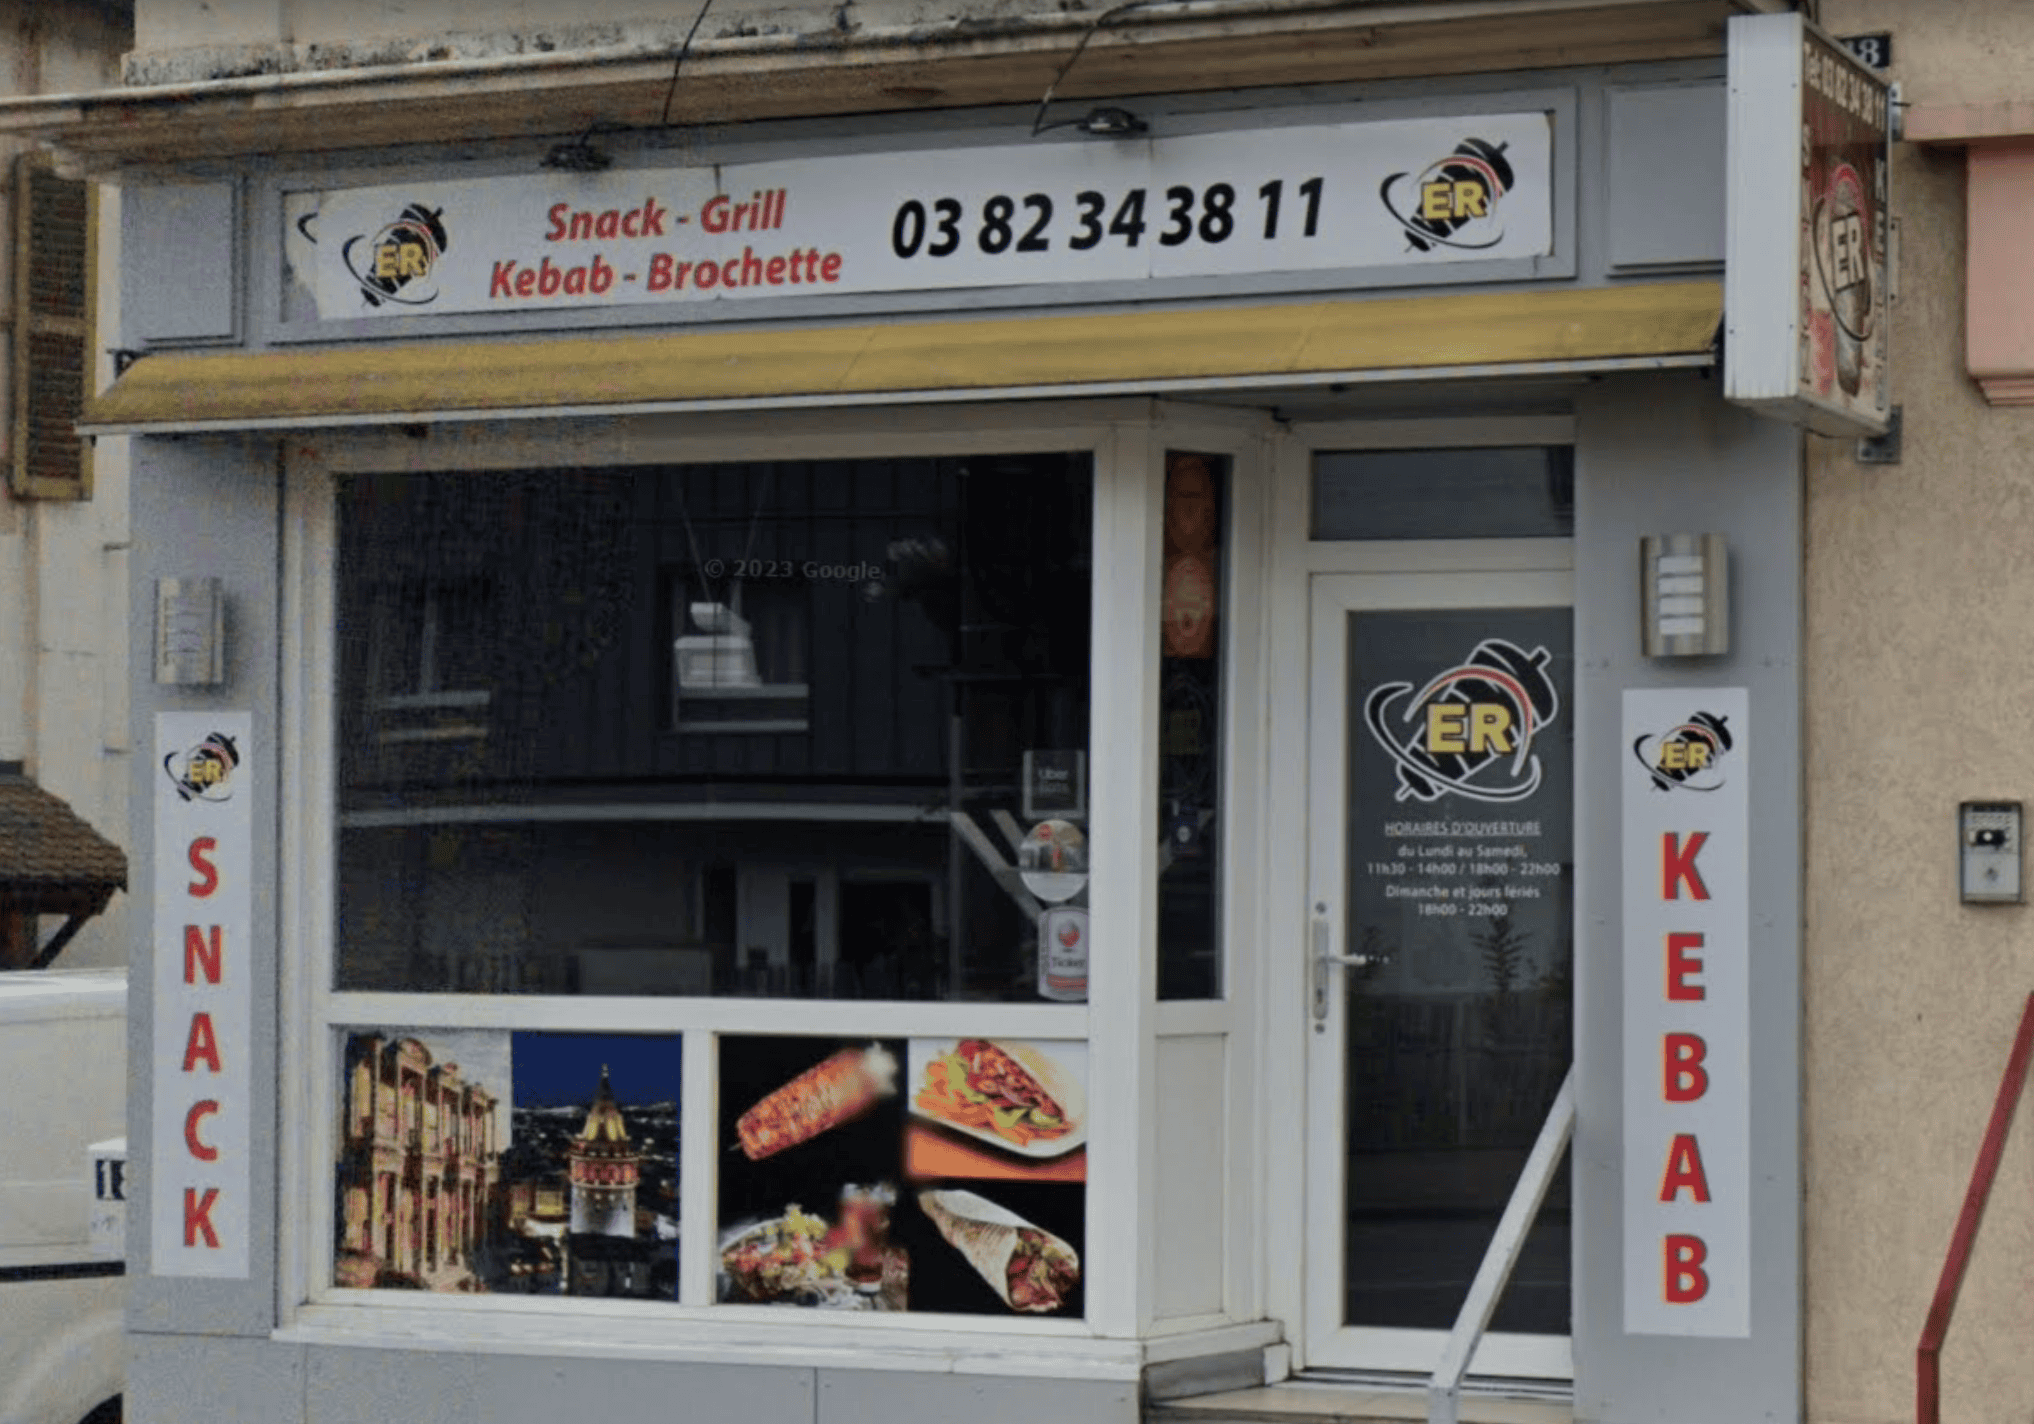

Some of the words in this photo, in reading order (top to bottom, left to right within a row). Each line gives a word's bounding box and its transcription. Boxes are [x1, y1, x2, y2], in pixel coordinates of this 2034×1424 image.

[546, 198, 668, 243] Snack
[699, 188, 787, 237] Grill
[891, 198, 962, 259] 03
[977, 193, 1054, 255] 82
[1069, 188, 1147, 251] 34
[1159, 182, 1236, 247] 38
[1258, 176, 1324, 241] 11
[1420, 179, 1487, 221] ER
[375, 242, 428, 279] ER
[1831, 212, 1867, 290] ER
[489, 256, 613, 300] Kebab
[646, 245, 845, 294] Brochette
[1427, 702, 1513, 753] ER
[190, 760, 223, 784] ER
[1660, 741, 1710, 770] ER
[1384, 821, 1448, 836] HORAIRES
[1452, 820, 1542, 836] D'OUVERTURE
[1367, 862, 1406, 875] 11h30
[1418, 862, 1457, 876] 14h00
[1470, 862, 1508, 876] 18h00
[1520, 862, 1561, 876] 22h00
[1397, 844, 1416, 857] du
[1418, 844, 1454, 857] Lundi
[1457, 847, 1474, 857] au
[1385, 884, 1449, 898] Dimanche
[1452, 887, 1465, 898] et
[1467, 885, 1501, 901] jours
[1418, 903, 1457, 916] 18h00
[1468, 903, 1508, 916] 22h00
[181, 835, 223, 1250] SNACK
[1657, 831, 1712, 1305] KEBAB
